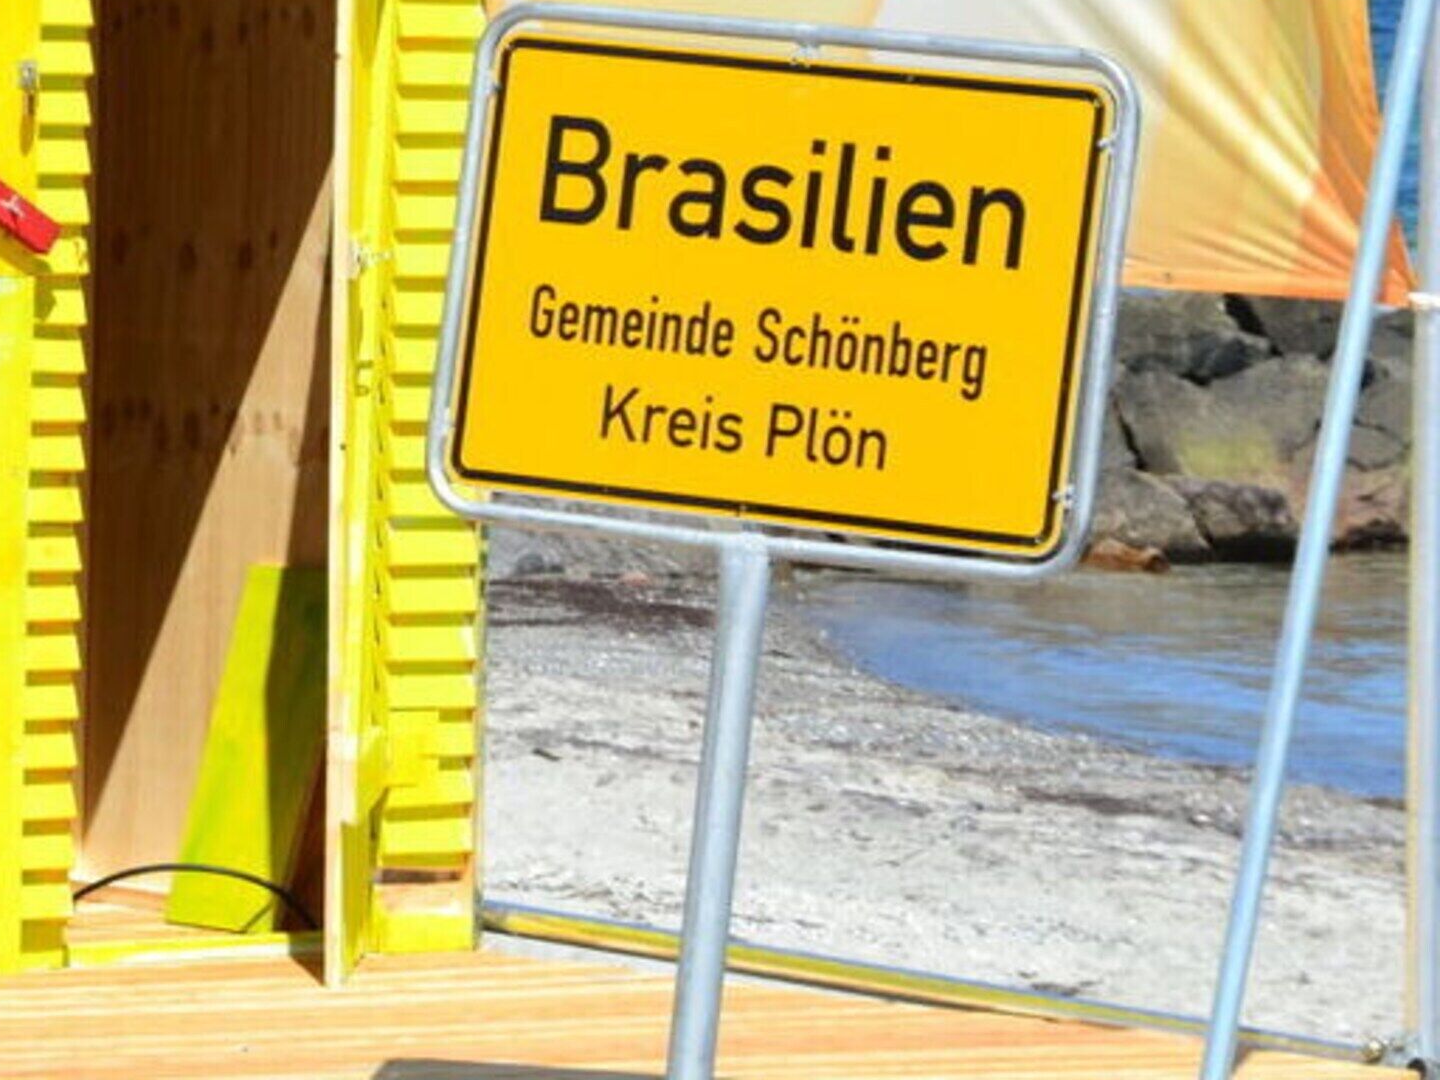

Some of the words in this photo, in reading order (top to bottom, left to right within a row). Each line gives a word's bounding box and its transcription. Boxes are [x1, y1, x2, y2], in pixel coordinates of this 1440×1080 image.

[539, 115, 1026, 270] Brasilien
[530, 284, 734, 358] Gemeinde
[755, 308, 987, 401] Schönberg
[601, 385, 743, 453] Kreis
[766, 403, 886, 470] Plön
